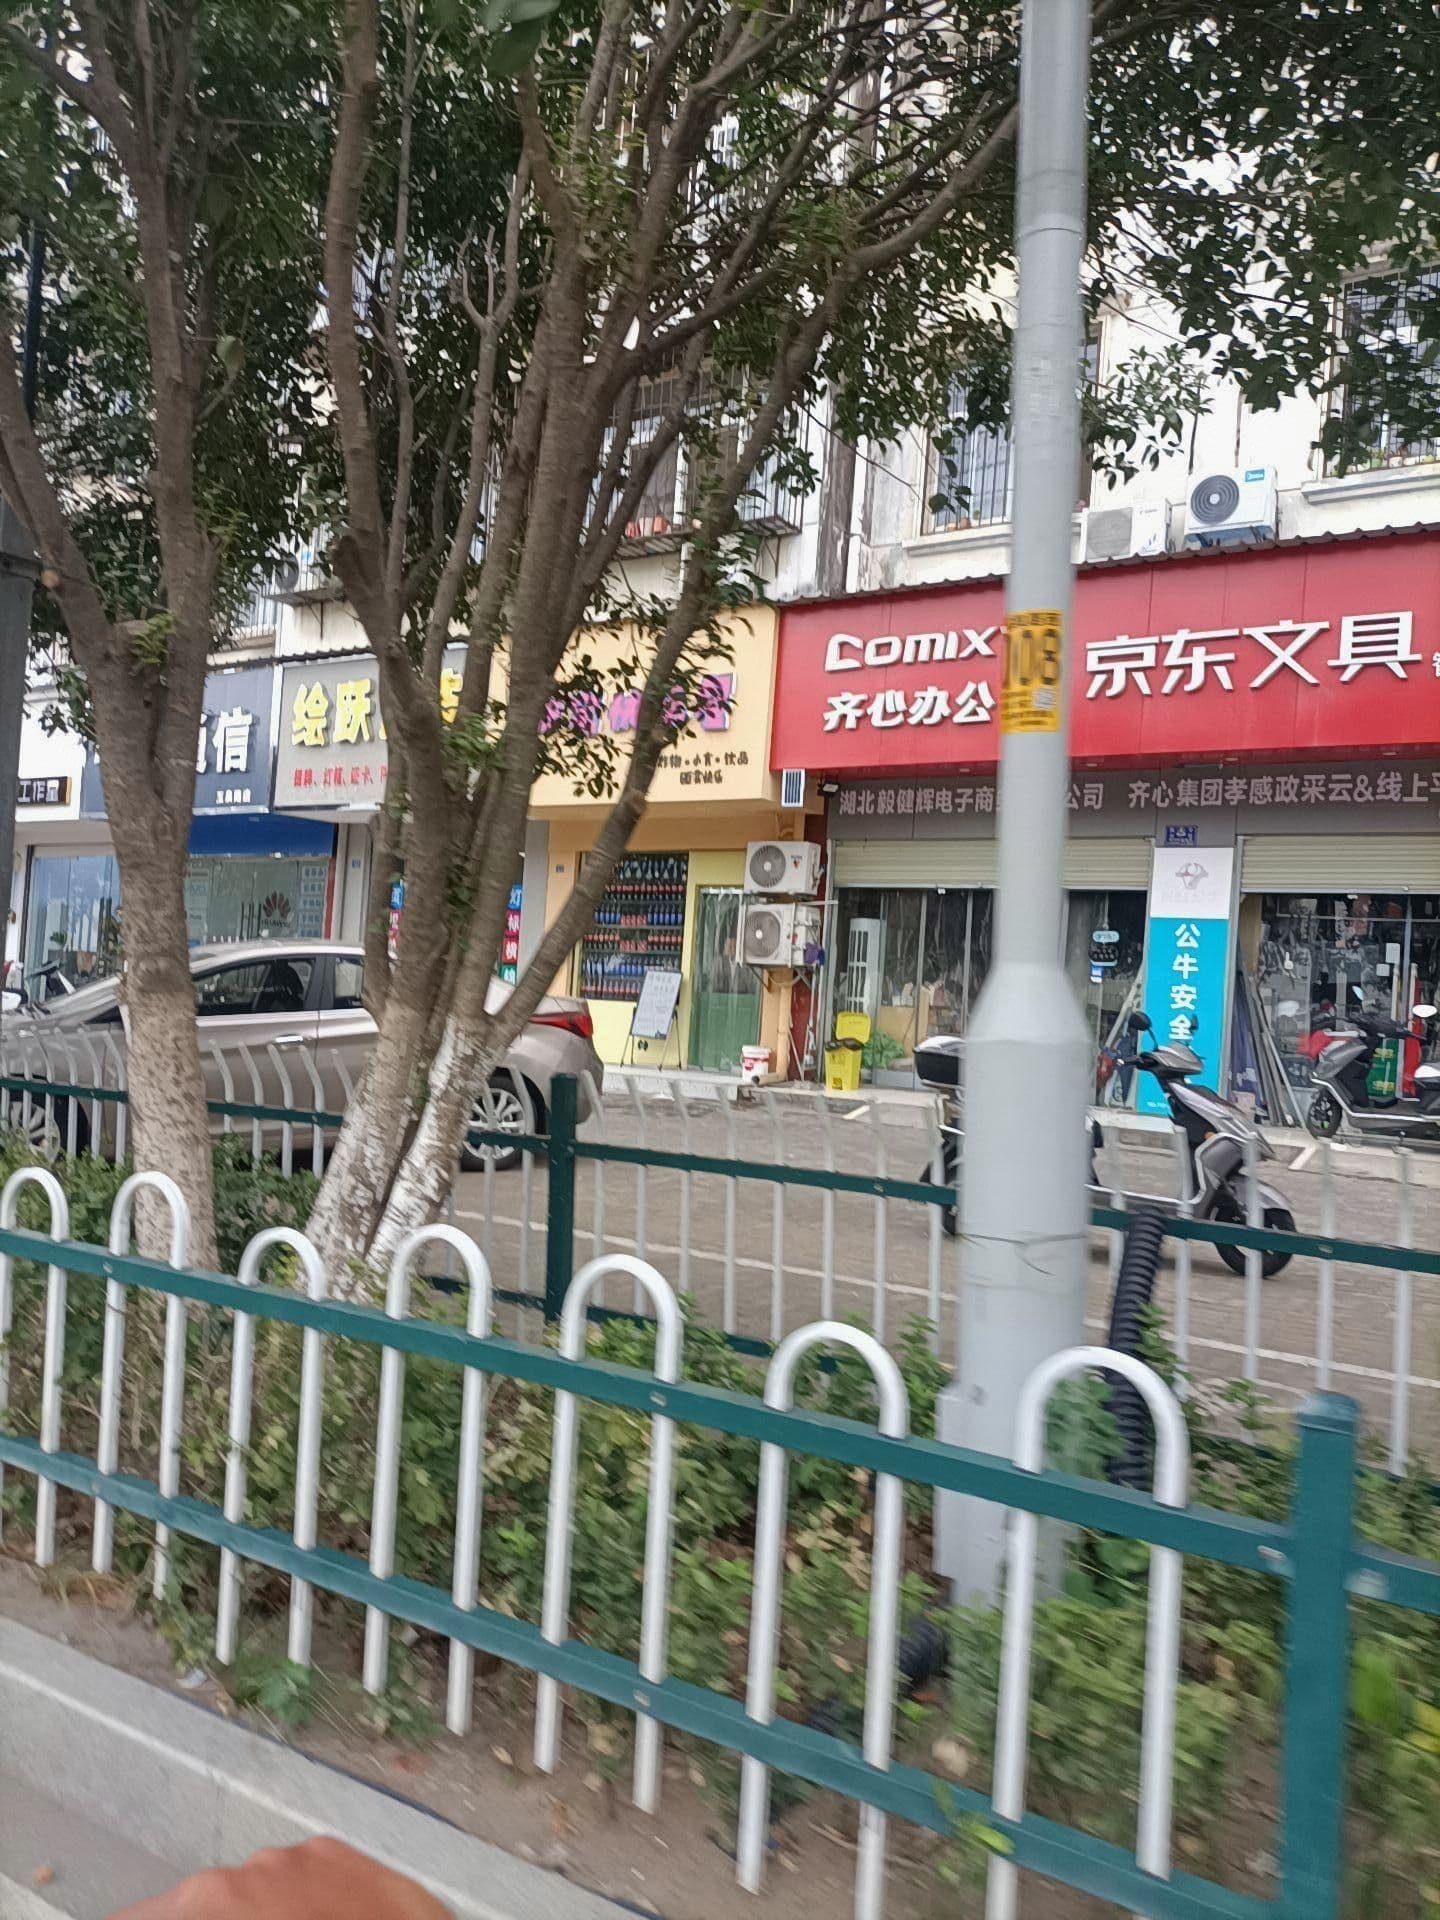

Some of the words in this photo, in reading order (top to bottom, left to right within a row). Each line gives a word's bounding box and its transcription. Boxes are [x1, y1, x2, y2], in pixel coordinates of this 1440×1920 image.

[1085, 609, 1423, 699] 京东文具
[292, 677, 388, 748] 绘跃
[822, 679, 997, 734] 齐心办公
